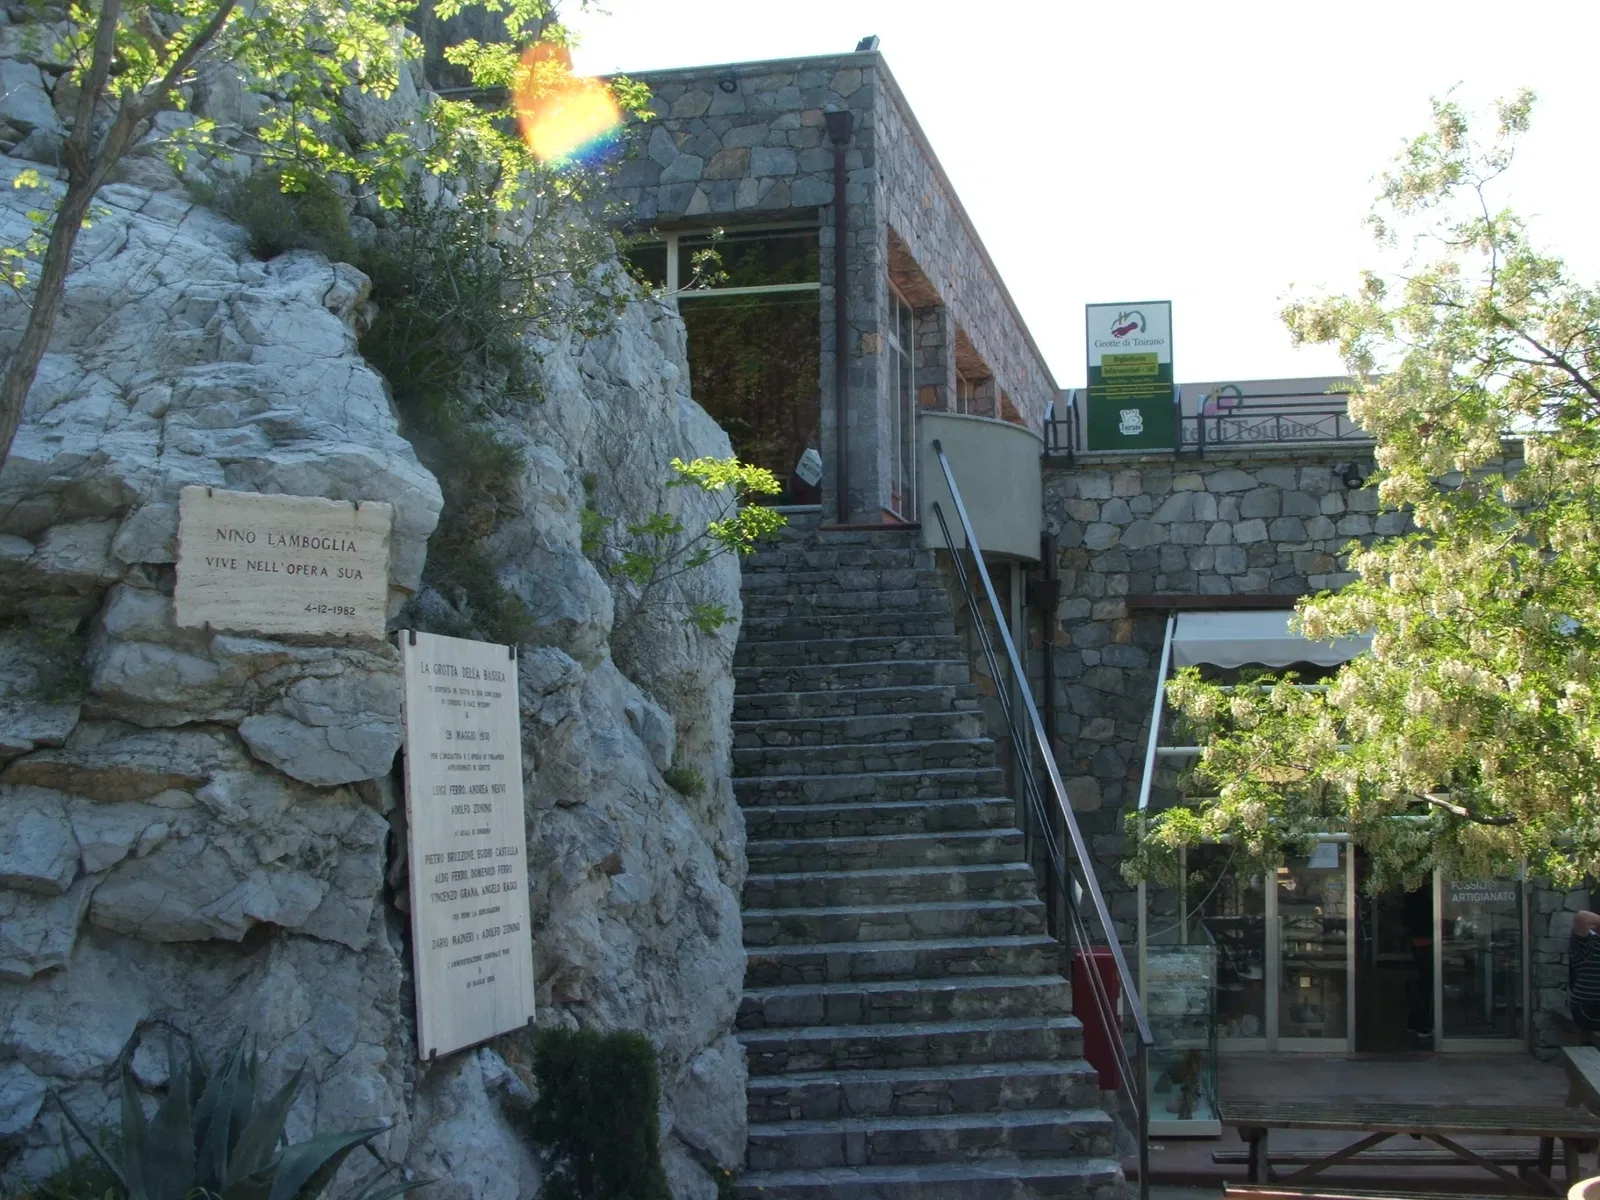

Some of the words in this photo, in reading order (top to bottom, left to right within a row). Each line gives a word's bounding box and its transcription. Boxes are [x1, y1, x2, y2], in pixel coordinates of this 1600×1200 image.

[1094, 340, 1120, 348] Grotte
[1122, 338, 1130, 347] di
[1132, 338, 1164, 346] Toirano
[216, 528, 256, 544] NINO
[268, 533, 357, 553] LAMBOGLIA
[205, 556, 237, 570] VIVE
[246, 559, 329, 577] NELL'OPERA
[338, 567, 364, 580] SUA
[420, 661, 430, 674] LA
[433, 663, 459, 677] GROTTA
[462, 666, 481, 680] DELLA
[455, 730, 476, 741] MAGGIO
[469, 784, 489, 795] ANDREA
[451, 804, 471, 815] ADOLFO
[425, 854, 445, 865] PIETRO
[495, 846, 519, 858] CASTELLA
[434, 872, 449, 883] ALDO
[497, 864, 513, 875] FERRO
[481, 883, 501, 896] ANGELO
[1451, 891, 1516, 903] ARTIGIANATO
[432, 937, 449, 950] DARIO
[482, 926, 501, 940] ADOLFO
